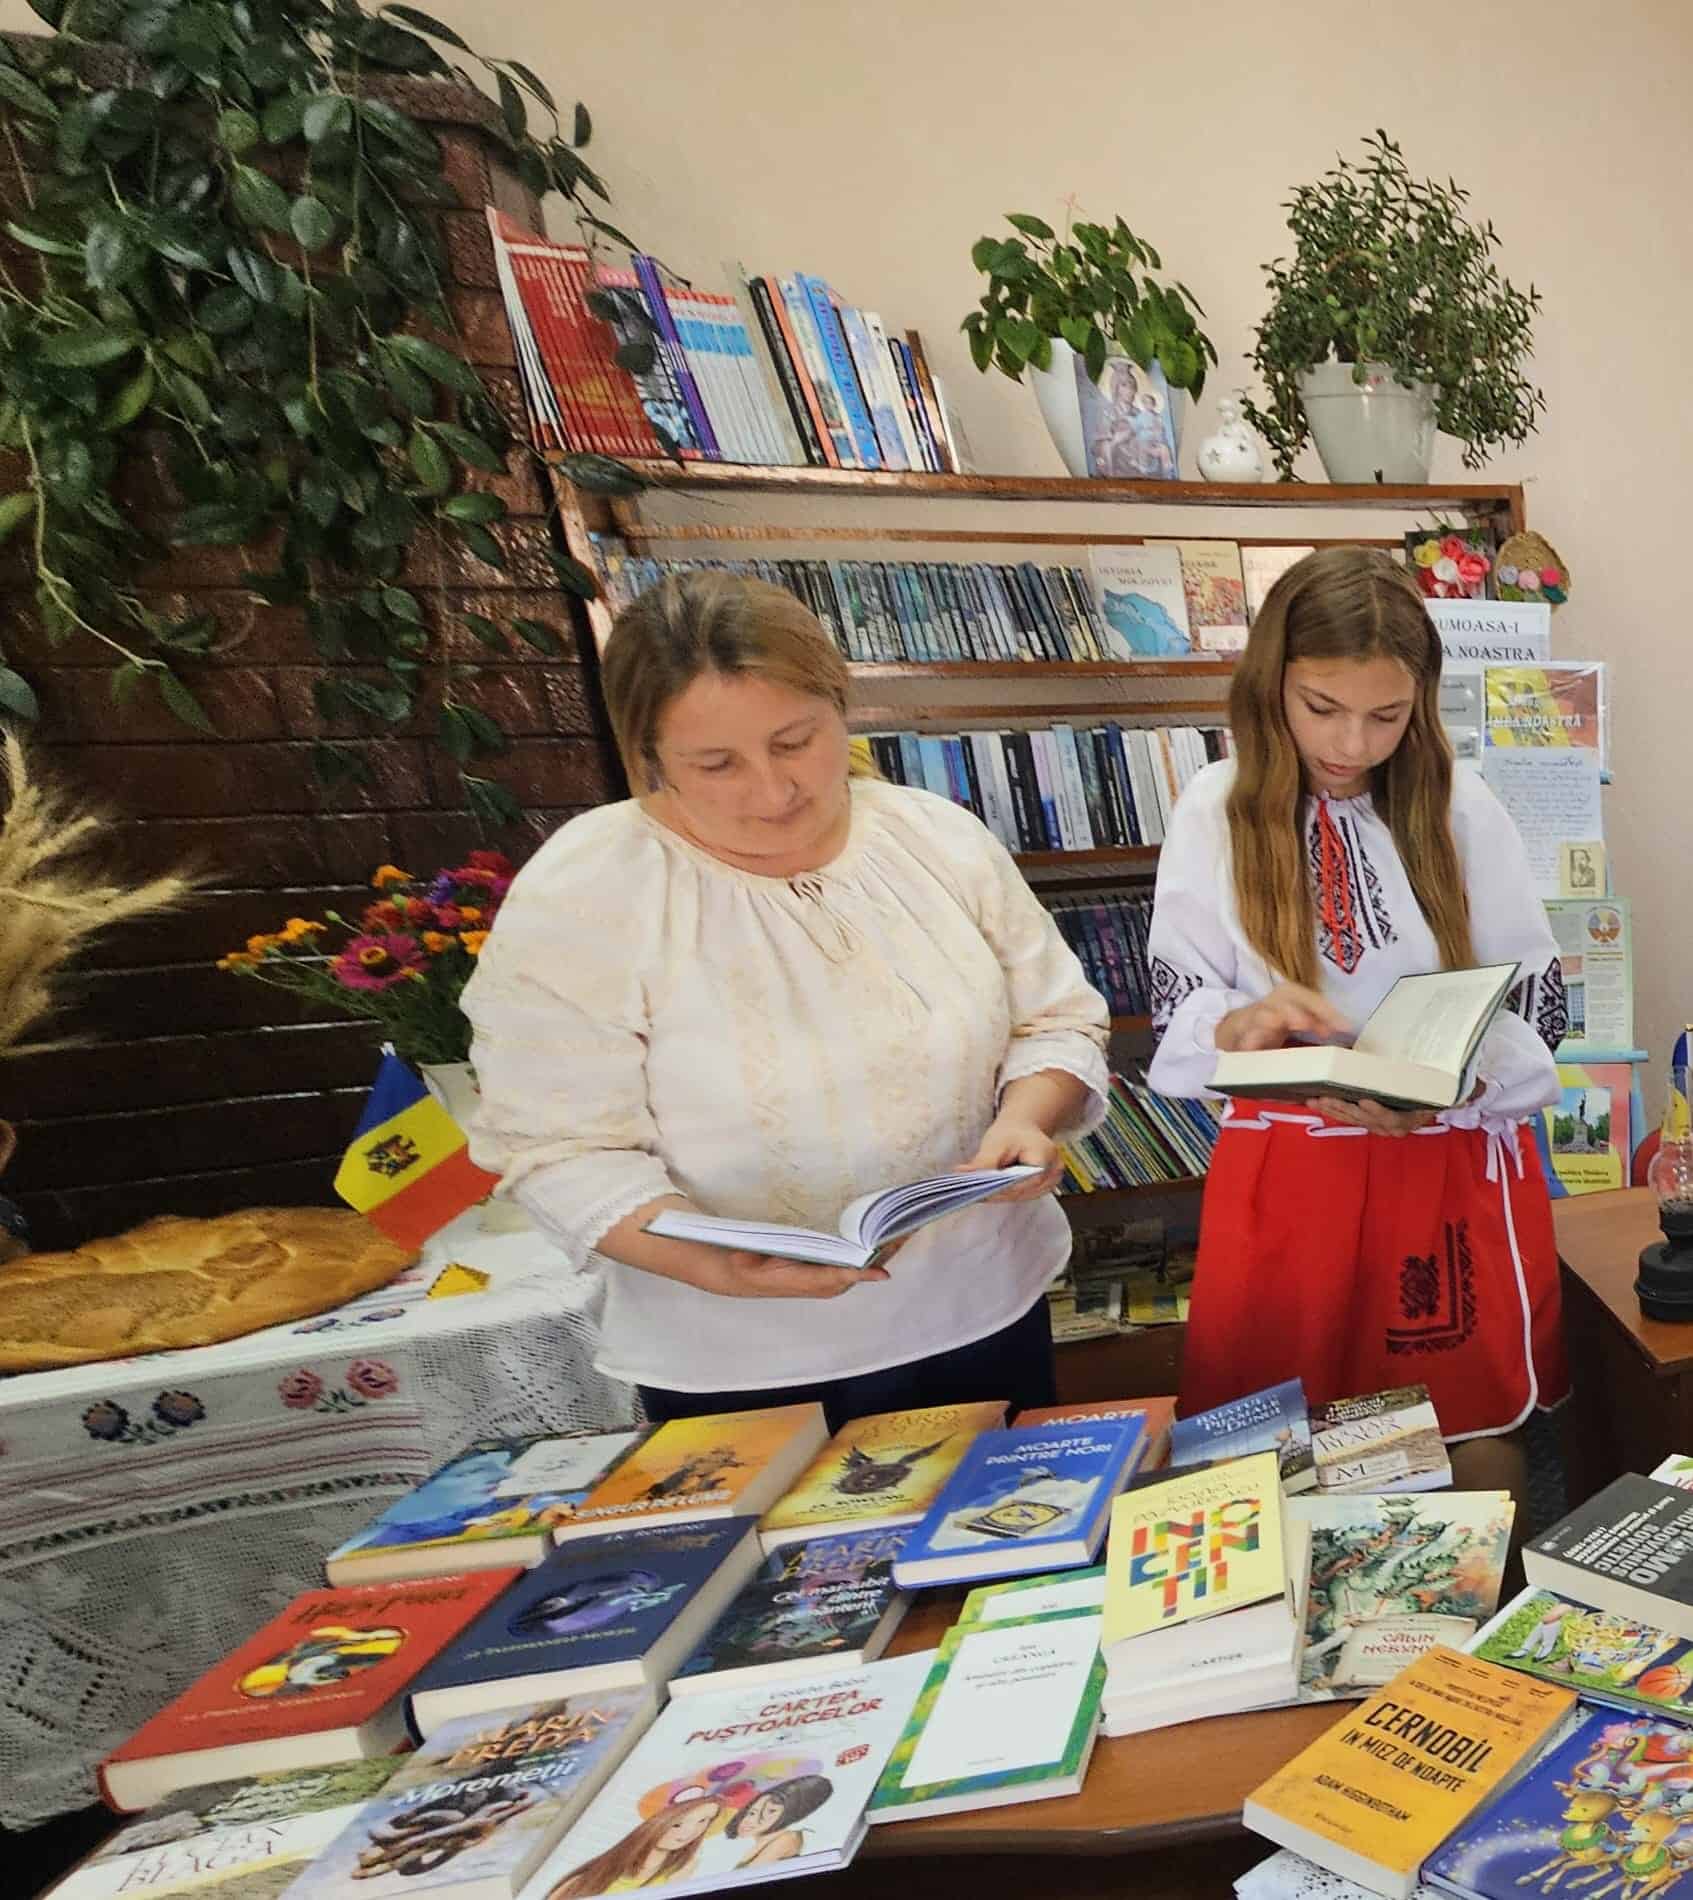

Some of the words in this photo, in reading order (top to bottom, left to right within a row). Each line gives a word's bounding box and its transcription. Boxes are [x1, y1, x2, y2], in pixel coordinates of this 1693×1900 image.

[1458, 645, 1537, 661] NOASTRA
[984, 1450, 1062, 1466] PRINTRE
[1065, 1443, 1114, 1458] NORI
[1013, 1436, 1095, 1454] MOARTE
[759, 1689, 861, 1717] CARTEA
[1358, 1736, 1400, 1761] MIEZ
[1392, 1751, 1417, 1770] DE
[1410, 1761, 1468, 1793] NOAPTE
